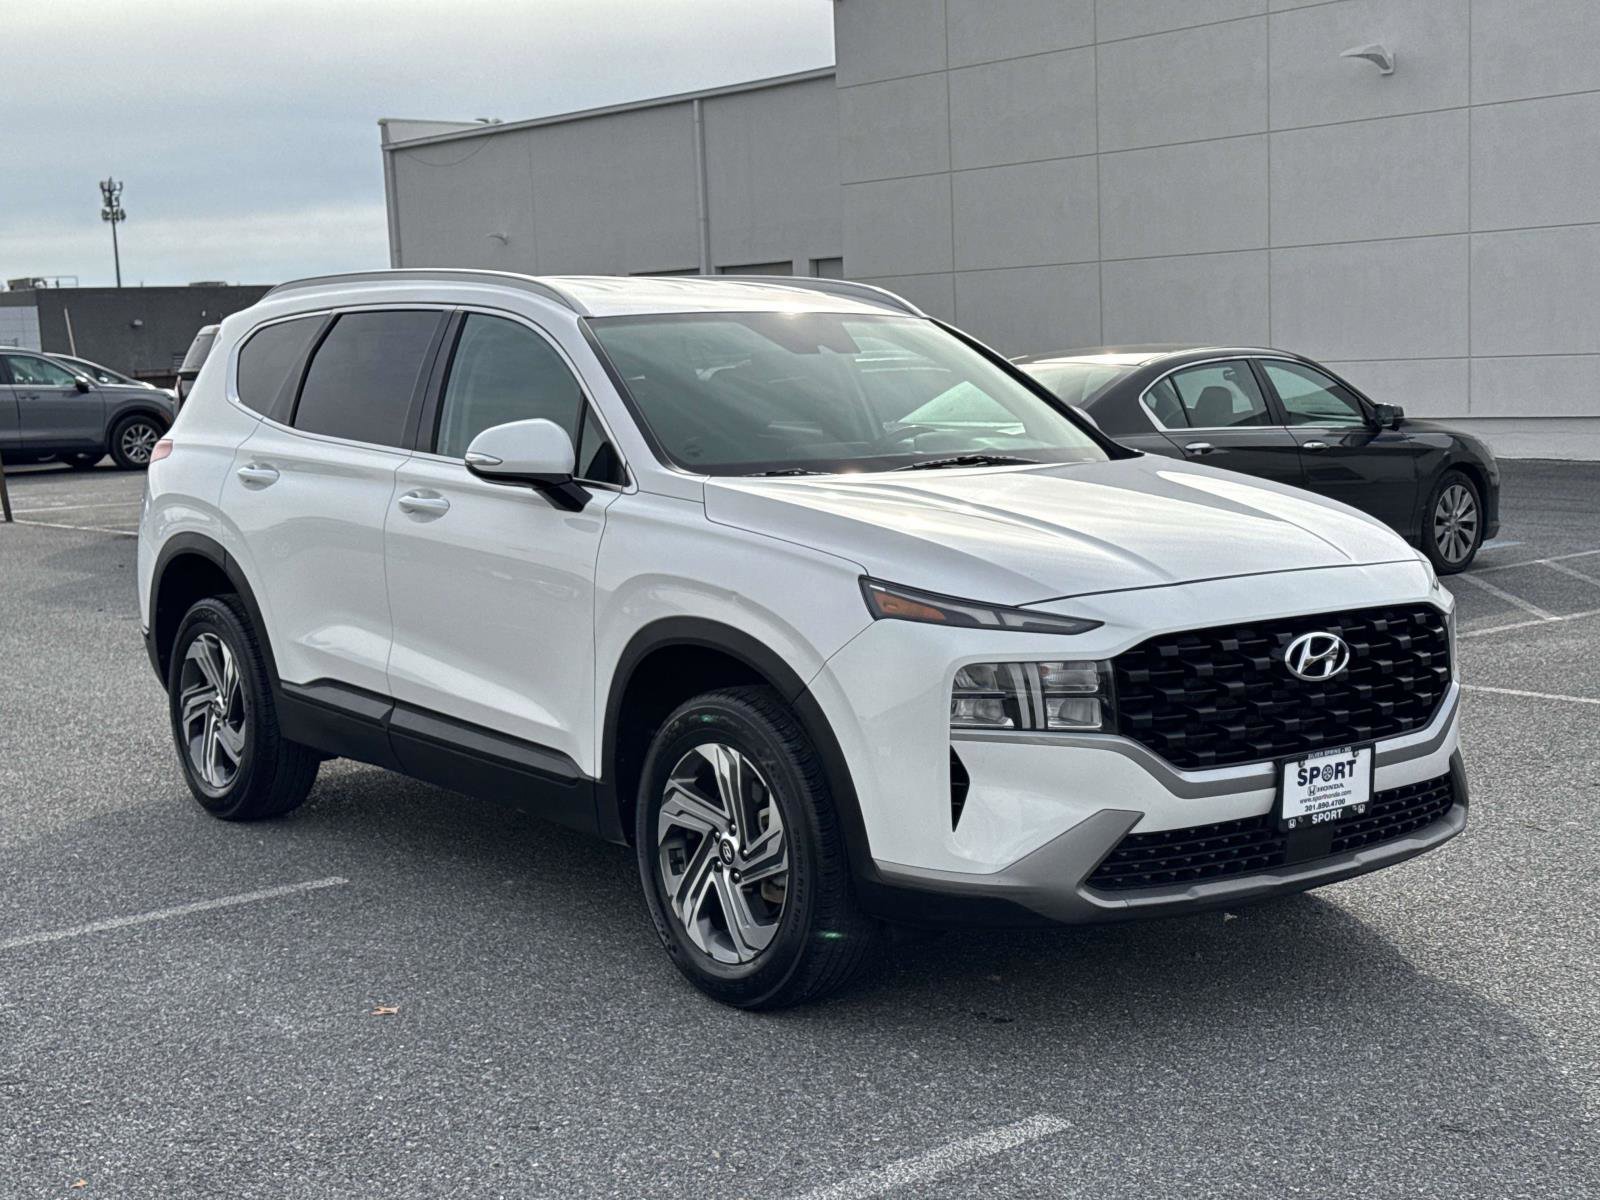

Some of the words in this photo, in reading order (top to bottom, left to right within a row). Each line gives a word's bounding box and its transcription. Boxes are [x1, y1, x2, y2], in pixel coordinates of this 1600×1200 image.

[1297, 759, 1357, 787] SPORT
[1317, 782, 1345, 793] HONDA
[1311, 808, 1343, 825] SPORT
